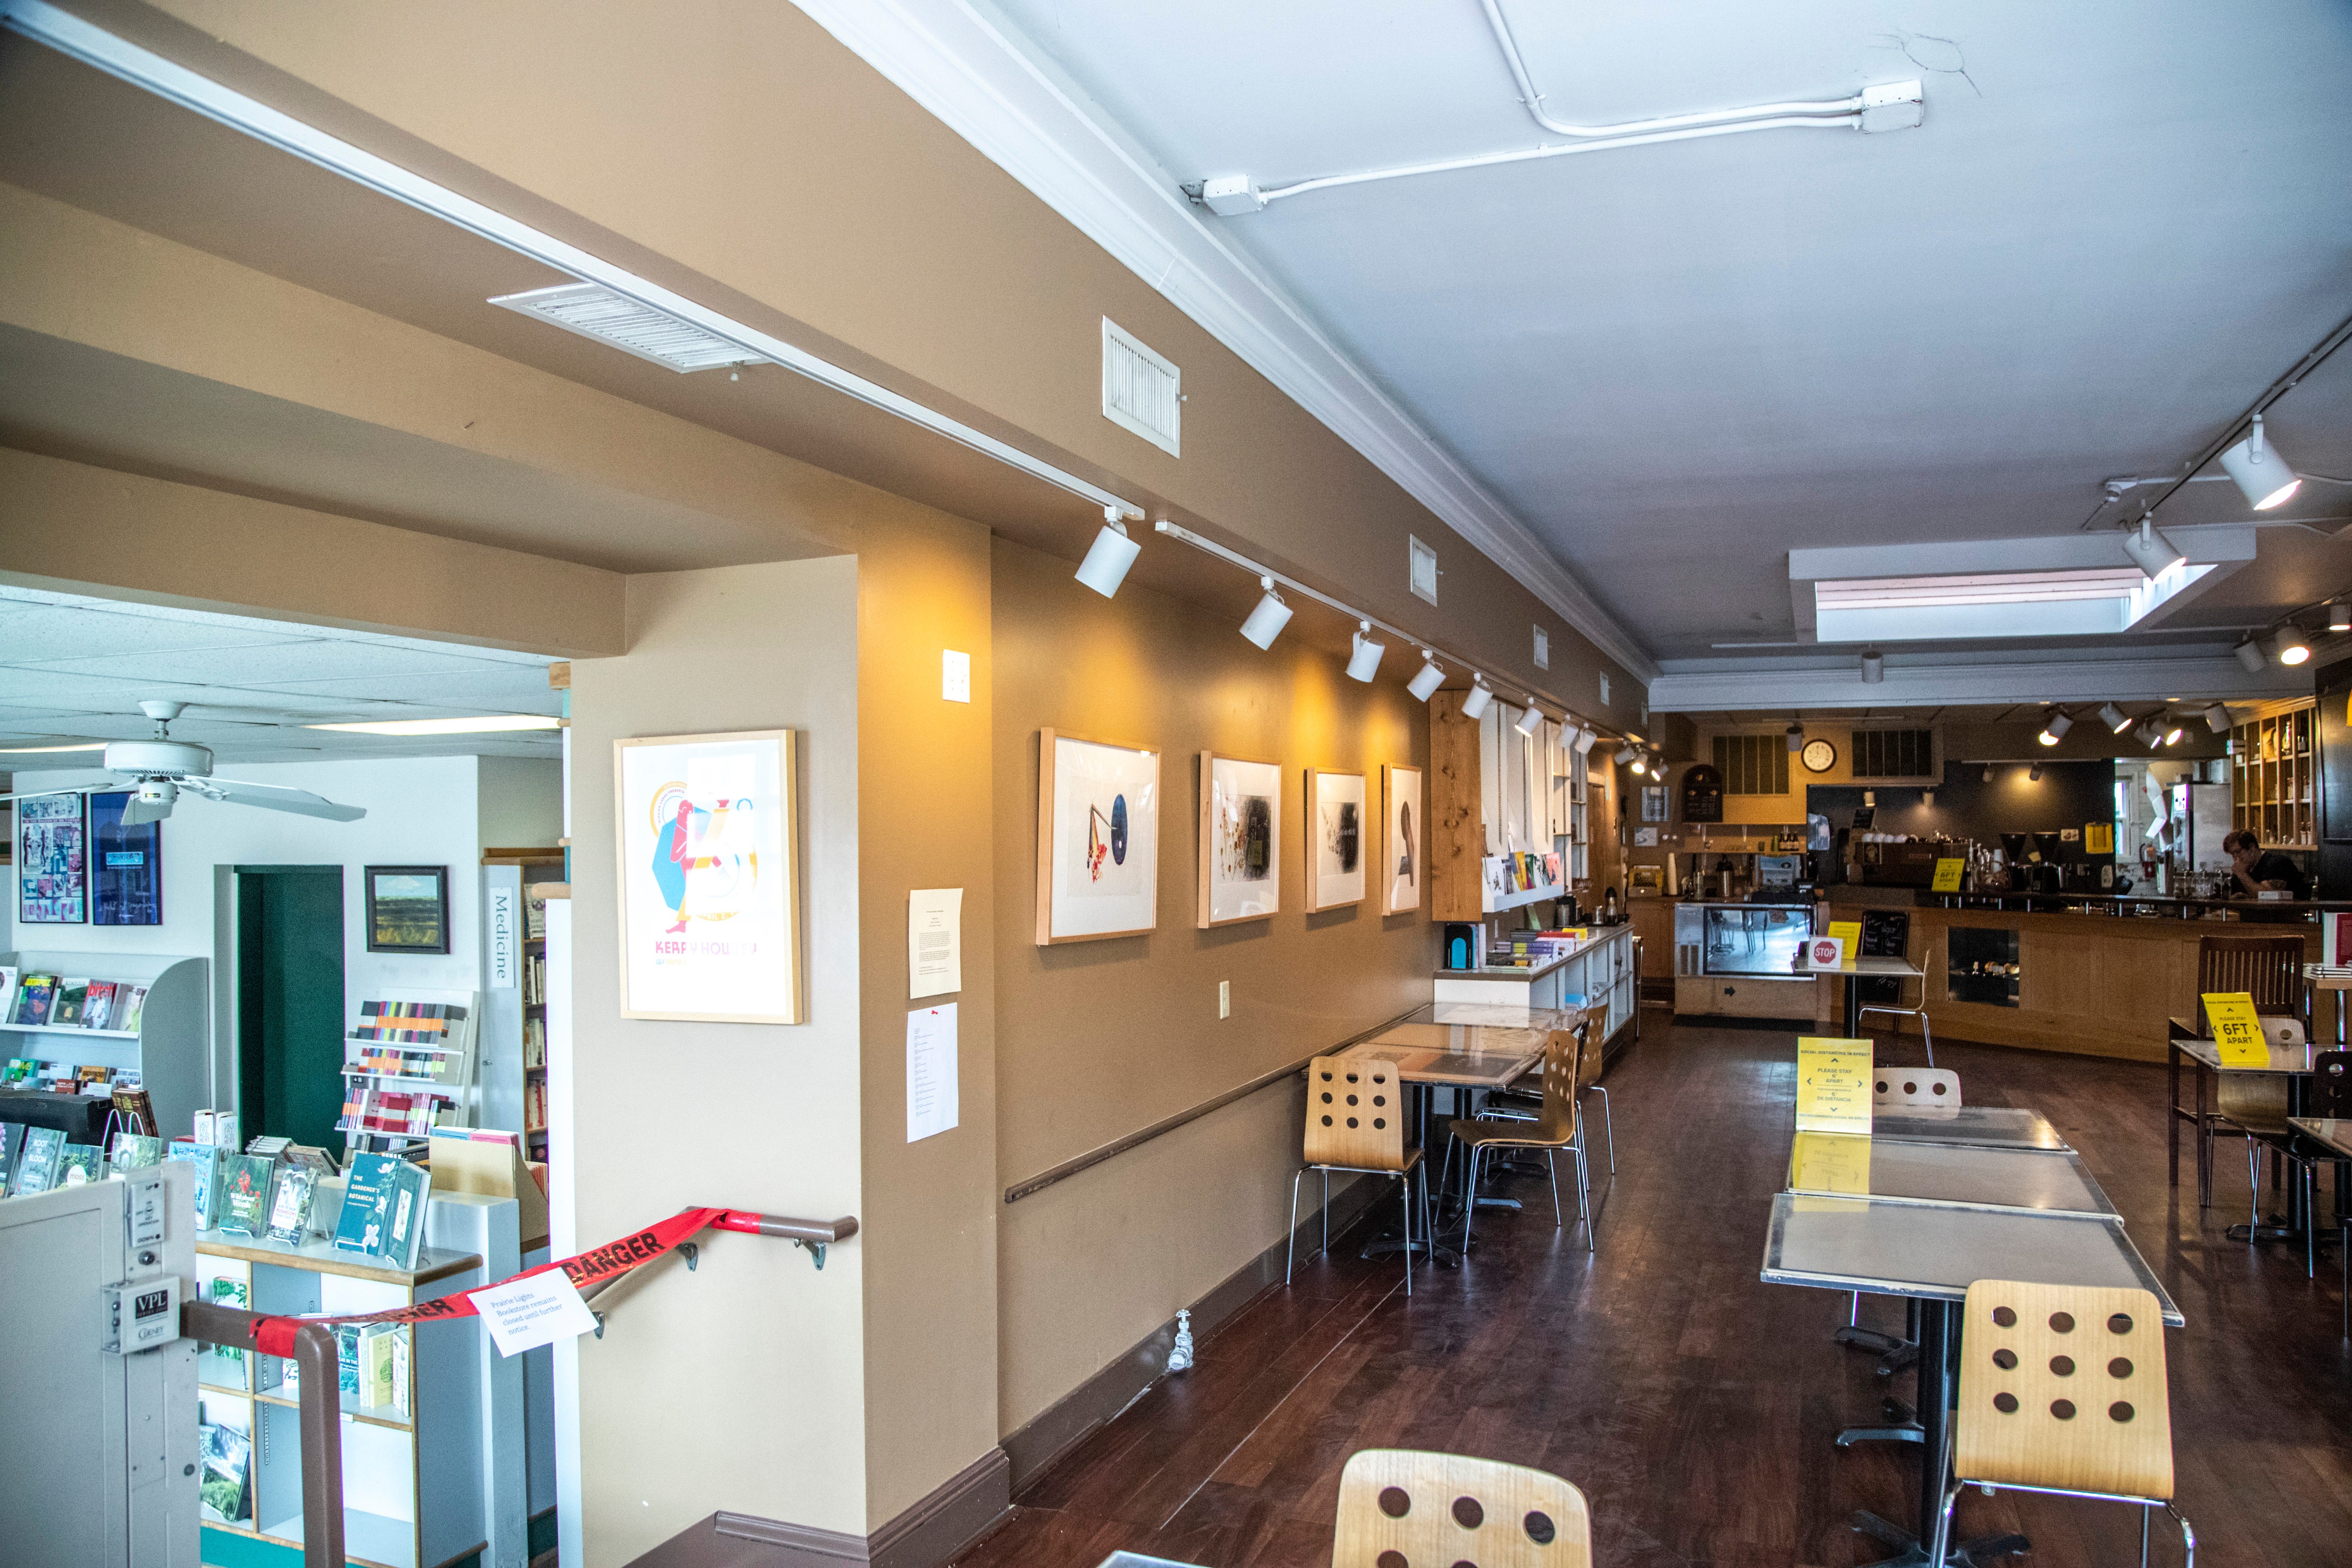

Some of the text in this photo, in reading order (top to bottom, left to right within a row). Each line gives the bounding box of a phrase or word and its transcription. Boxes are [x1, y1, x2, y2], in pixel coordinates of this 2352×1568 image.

[496, 896, 508, 979] Medicine
[1815, 947, 1835, 958] STOP
[87, 982, 113, 997] bitch
[2223, 1023, 2248, 1035] 6FT
[33, 1139, 49, 1147] ROOT
[28, 1154, 47, 1163] BLOOM
[351, 1184, 380, 1194] GARDENER'S
[348, 1193, 375, 1202] BOTANICAL
[233, 1199, 251, 1209] Weeds
[276, 1208, 297, 1217] MUSHROOMS
[559, 1232, 665, 1283] DANGER
[138, 1292, 166, 1311] VPL
[490, 1293, 535, 1309] Prairie Lights
[496, 1295, 557, 1317] Bookstore remains
[502, 1304, 564, 1326] closed until further
[508, 1324, 531, 1335] notice.
